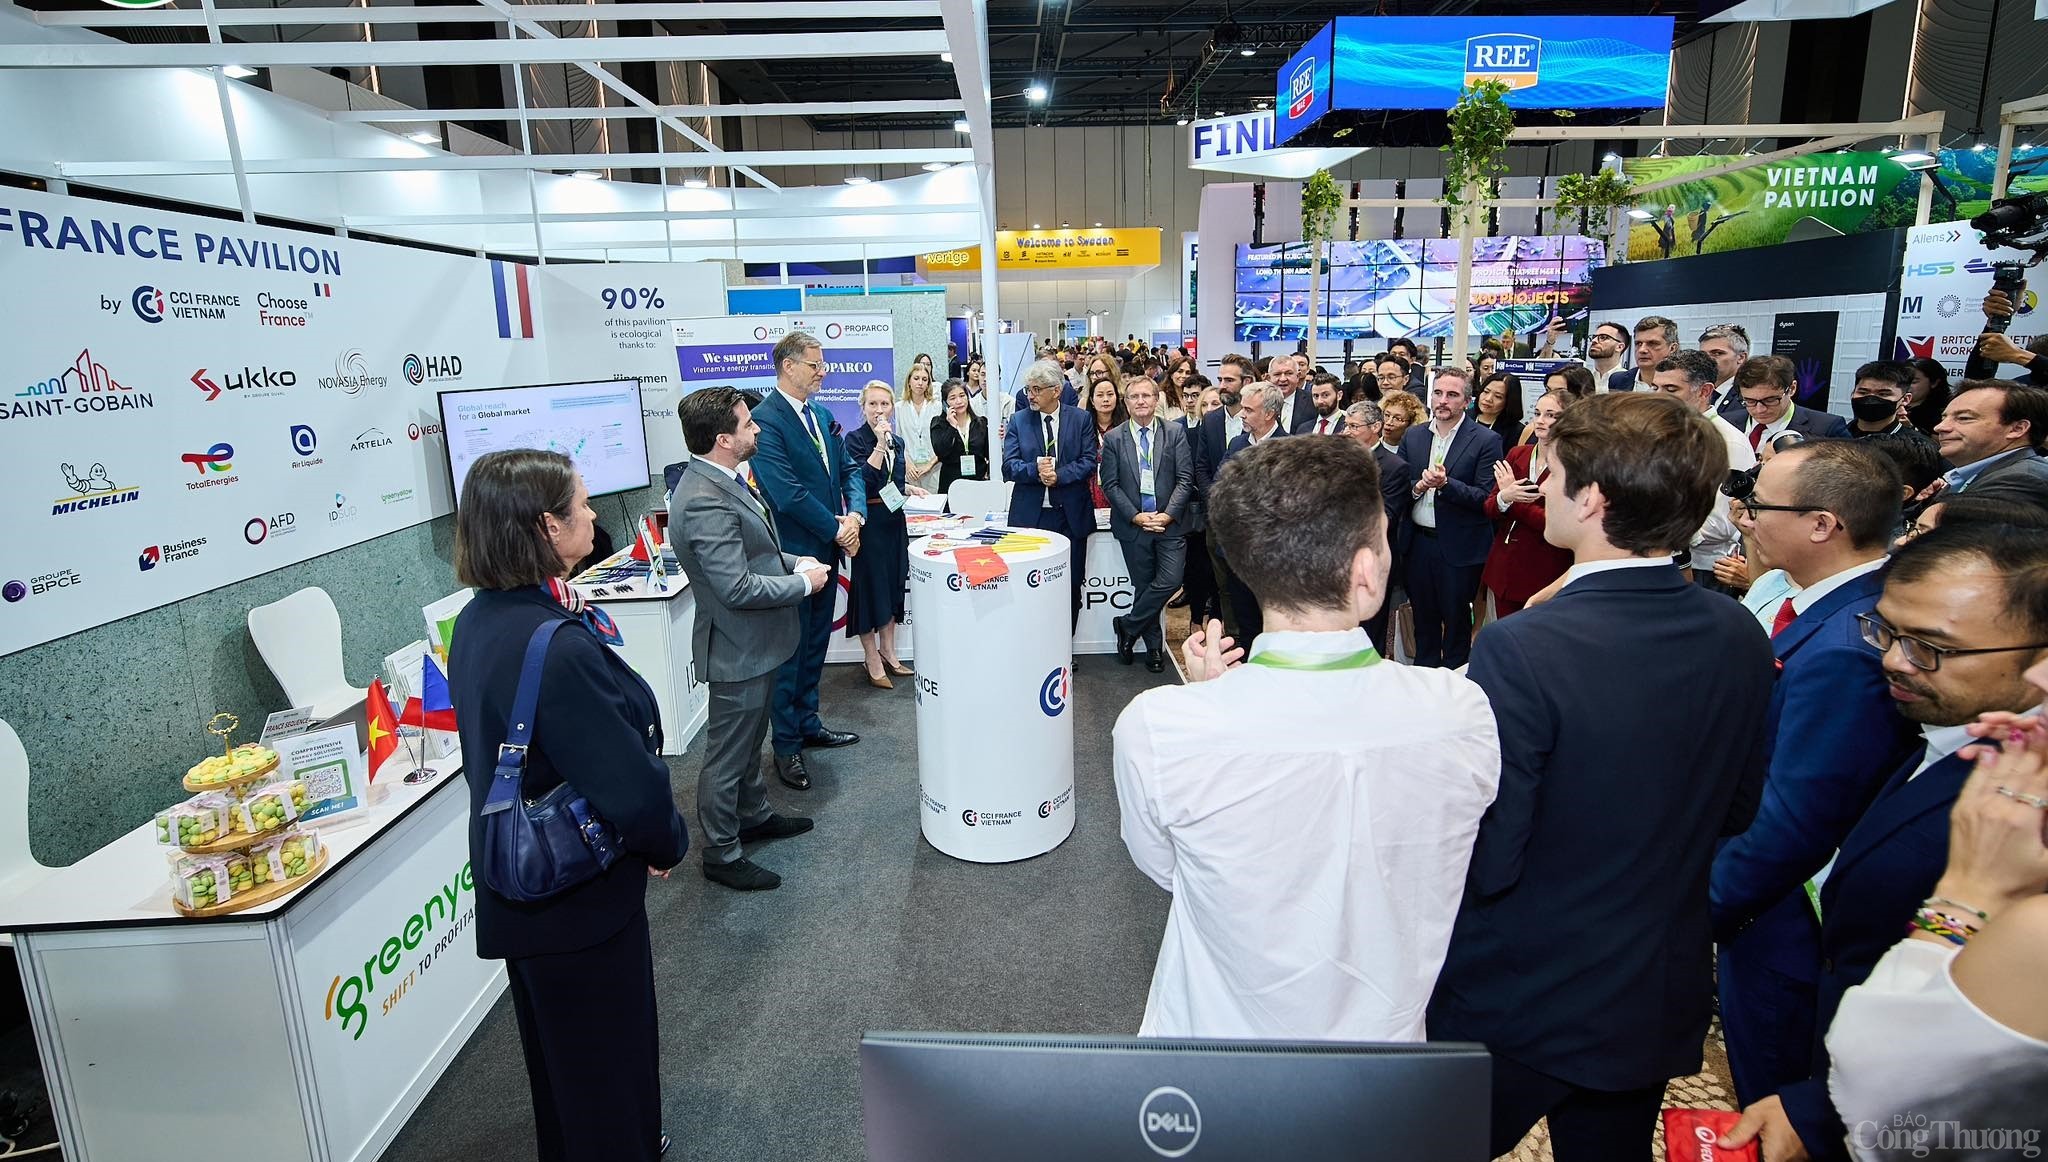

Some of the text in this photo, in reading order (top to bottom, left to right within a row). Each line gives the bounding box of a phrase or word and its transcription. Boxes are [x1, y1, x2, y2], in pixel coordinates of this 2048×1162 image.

[1292, 64, 1313, 100] REE
[1194, 116, 1275, 159] FINL
[1767, 165, 1878, 186] VIETNAM
[1764, 189, 1874, 208] PAVILION
[1017, 236, 1114, 248] Welcome to Sweden
[1912, 233, 1945, 244] Allens
[195, 233, 341, 276] PAVILION
[927, 250, 969, 266] verige
[101, 291, 240, 314] by CCI FRANCE
[257, 292, 308, 310] Choose
[601, 287, 665, 310] 90%
[1500, 291, 1570, 304] PROJECTS
[172, 307, 226, 320] VIETNAM
[605, 318, 666, 327] of this pavilion
[844, 324, 889, 332] PROPARCO
[620, 330, 661, 339] ecological
[769, 327, 785, 335] AFD
[619, 341, 656, 349] thanks to:
[1942, 335, 1978, 344] BRITCH
[1941, 347, 1973, 355] WORK
[702, 352, 769, 365] We support
[426, 355, 462, 378] HAD
[692, 366, 726, 374] Vietnam's
[727, 364, 748, 372] energy
[824, 362, 872, 373] OPARCO
[1946, 368, 1964, 377] NER
[224, 366, 296, 391] ukko
[318, 375, 388, 389] NOVASIA Energy
[0, 392, 154, 420] SAINT-GOBAIN
[457, 401, 507, 412] Global reach
[459, 413, 469, 421] for
[478, 410, 503, 419] Global
[504, 408, 531, 417] market
[420, 424, 443, 436] VEOL
[350, 437, 393, 451] ARTELIA
[292, 457, 323, 469] Air Liquide
[186, 475, 239, 491] TotalEnergies
[52, 490, 140, 515] MICHELIN
[270, 512, 295, 530] AFD
[163, 537, 207, 554] Business
[164, 547, 199, 563] France
[31, 569, 72, 584] GROUPE
[984, 575, 1009, 583] ANCE
[1082, 576, 1130, 588] ROUP
[32, 574, 82, 595] BPCE
[1086, 590, 1133, 610] PC
[291, 740, 342, 756] COMPREHENSIVE
[311, 806, 329, 816] SCAN
[994, 810, 1022, 819] FRANCE
[336, 861, 475, 1041] greenye
[383, 907, 474, 1017] SHIFT TO PROFITA
[1147, 1111, 1195, 1133] DELL
[1700, 1143, 1714, 1162] VEO
